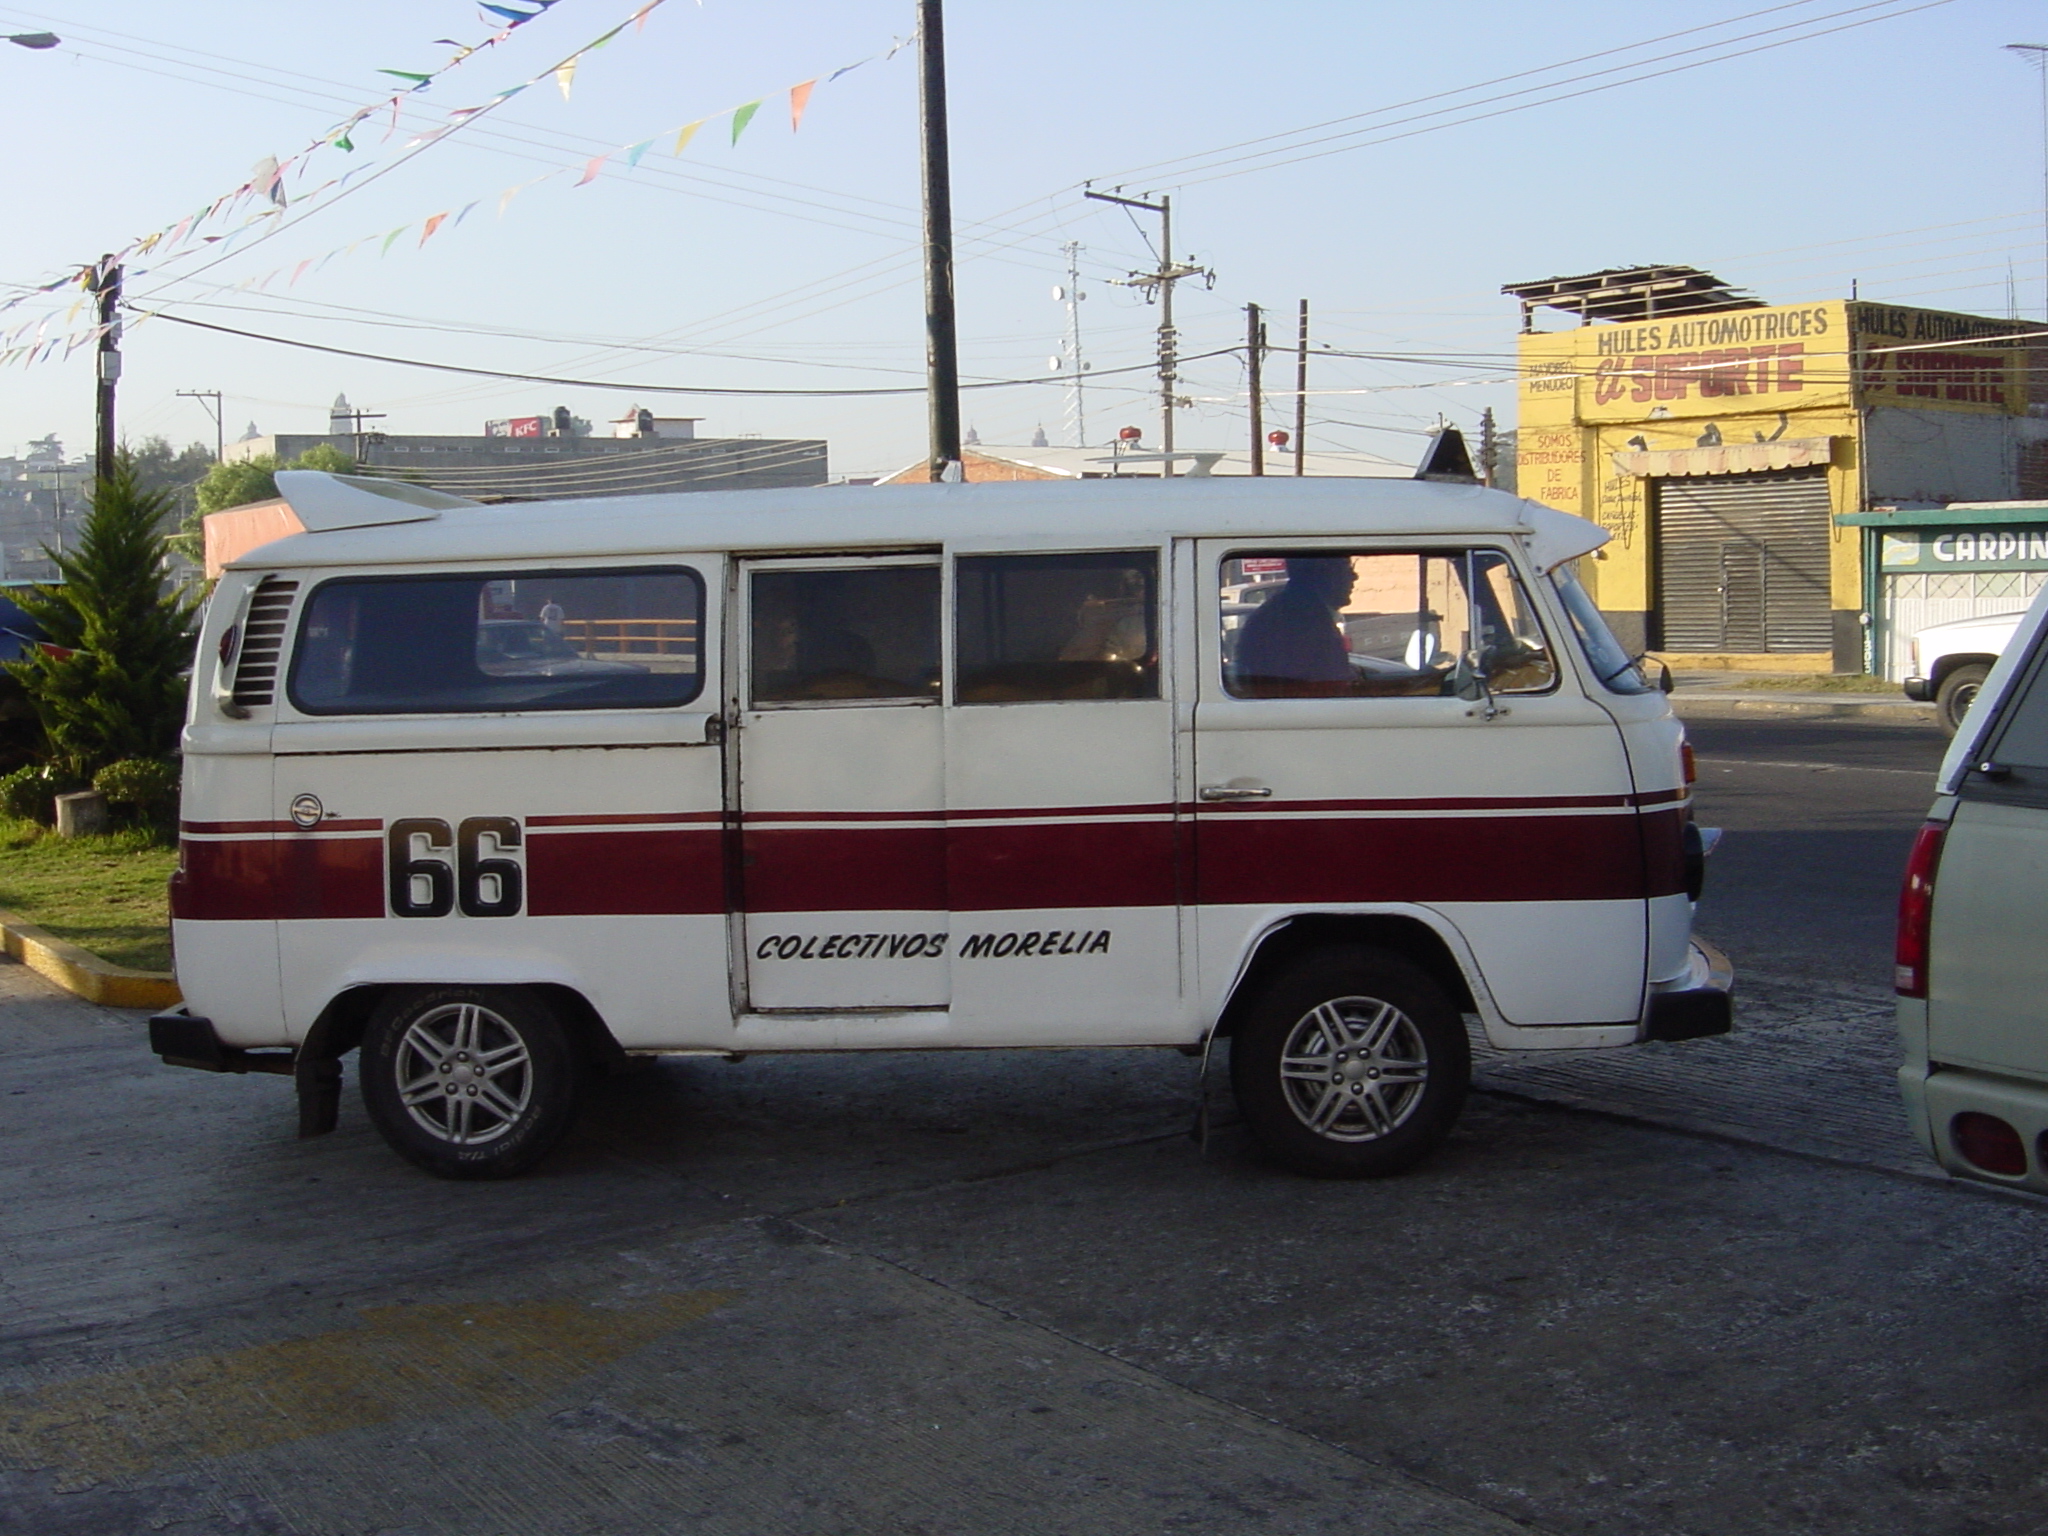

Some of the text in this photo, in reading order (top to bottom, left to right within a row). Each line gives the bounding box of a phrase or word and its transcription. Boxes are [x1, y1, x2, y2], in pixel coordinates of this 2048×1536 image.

[1599, 307, 1828, 355] HULES AUTOMOTRICES
[1857, 306, 1907, 339] HULES
[1529, 377, 1574, 394] MENUDEO
[1631, 341, 1804, 403] SOPORTE
[1896, 351, 2004, 404] SOPORTE
[514, 420, 538, 438] KFC
[1538, 434, 1572, 448] SOMOS
[1547, 468, 1562, 482] DE
[1541, 486, 1578, 500] FABRICA
[1932, 532, 2048, 562] CARPIN
[389, 816, 522, 918] 66
[756, 929, 1112, 961] COLECTIVOS MORELIA
